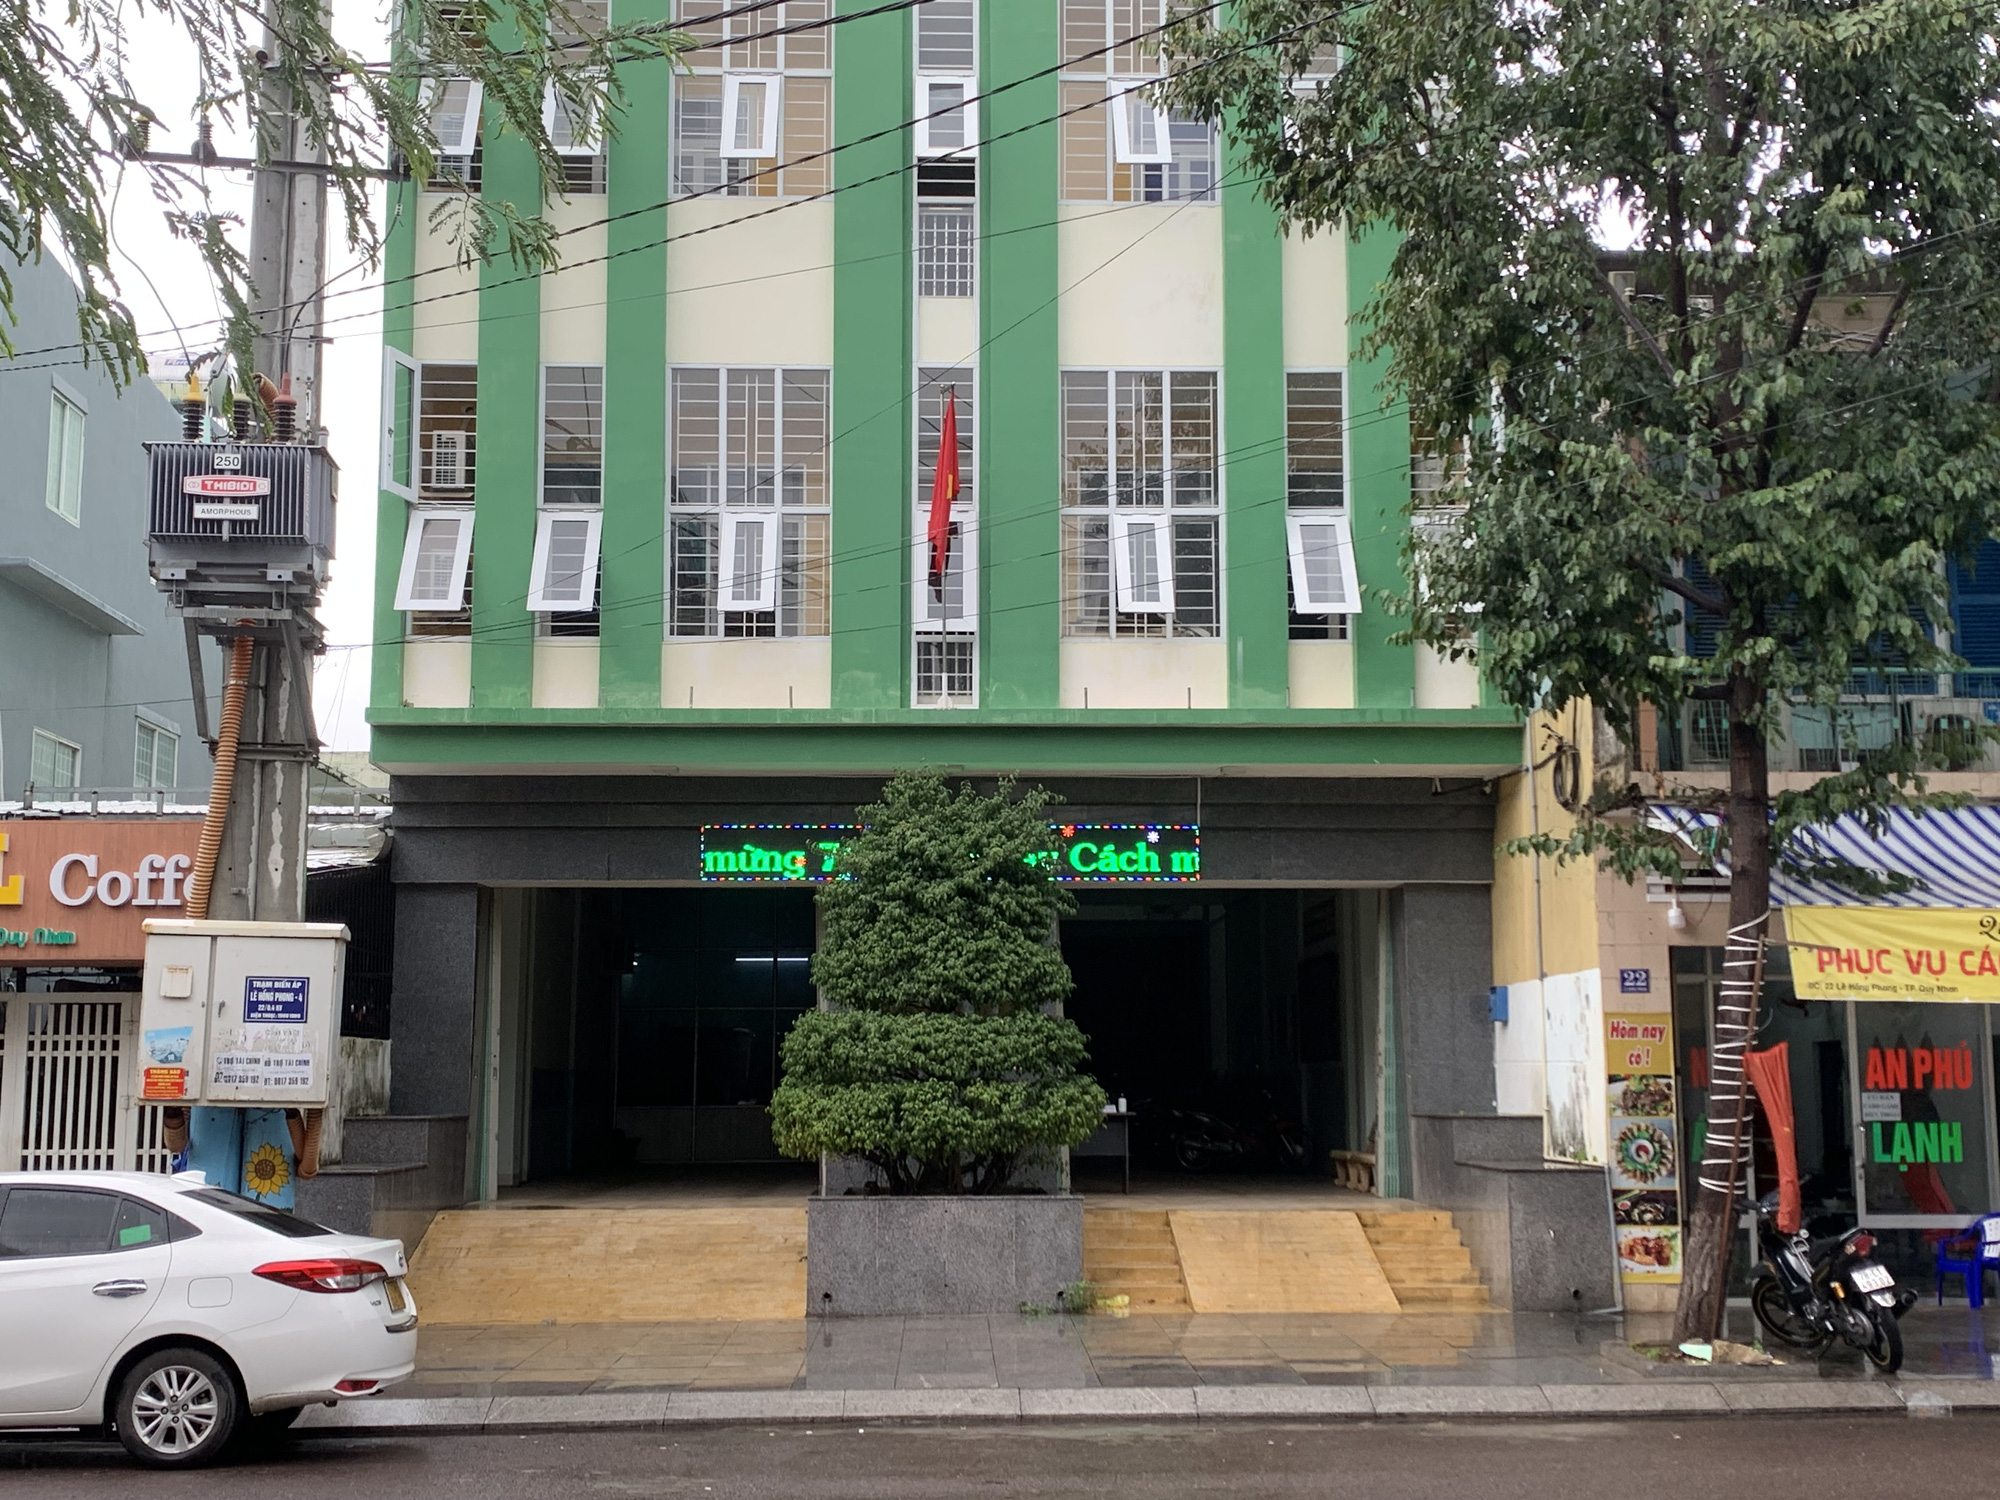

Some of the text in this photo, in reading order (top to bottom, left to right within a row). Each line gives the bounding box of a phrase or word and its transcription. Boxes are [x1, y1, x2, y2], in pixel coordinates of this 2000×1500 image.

[215, 456, 240, 467] 250
[204, 480, 254, 492] THIBIDI
[200, 508, 252, 516] AMORPHOUS
[1068, 842, 1162, 873] Cách
[1817, 944, 2000, 982] PHỤC VỤ CÁ
[1623, 970, 1648, 987] 22
[1642, 1025, 1666, 1043] nay
[1866, 1040, 1973, 1090] AN PHÚ
[1872, 1122, 1964, 1171] LẠNH
